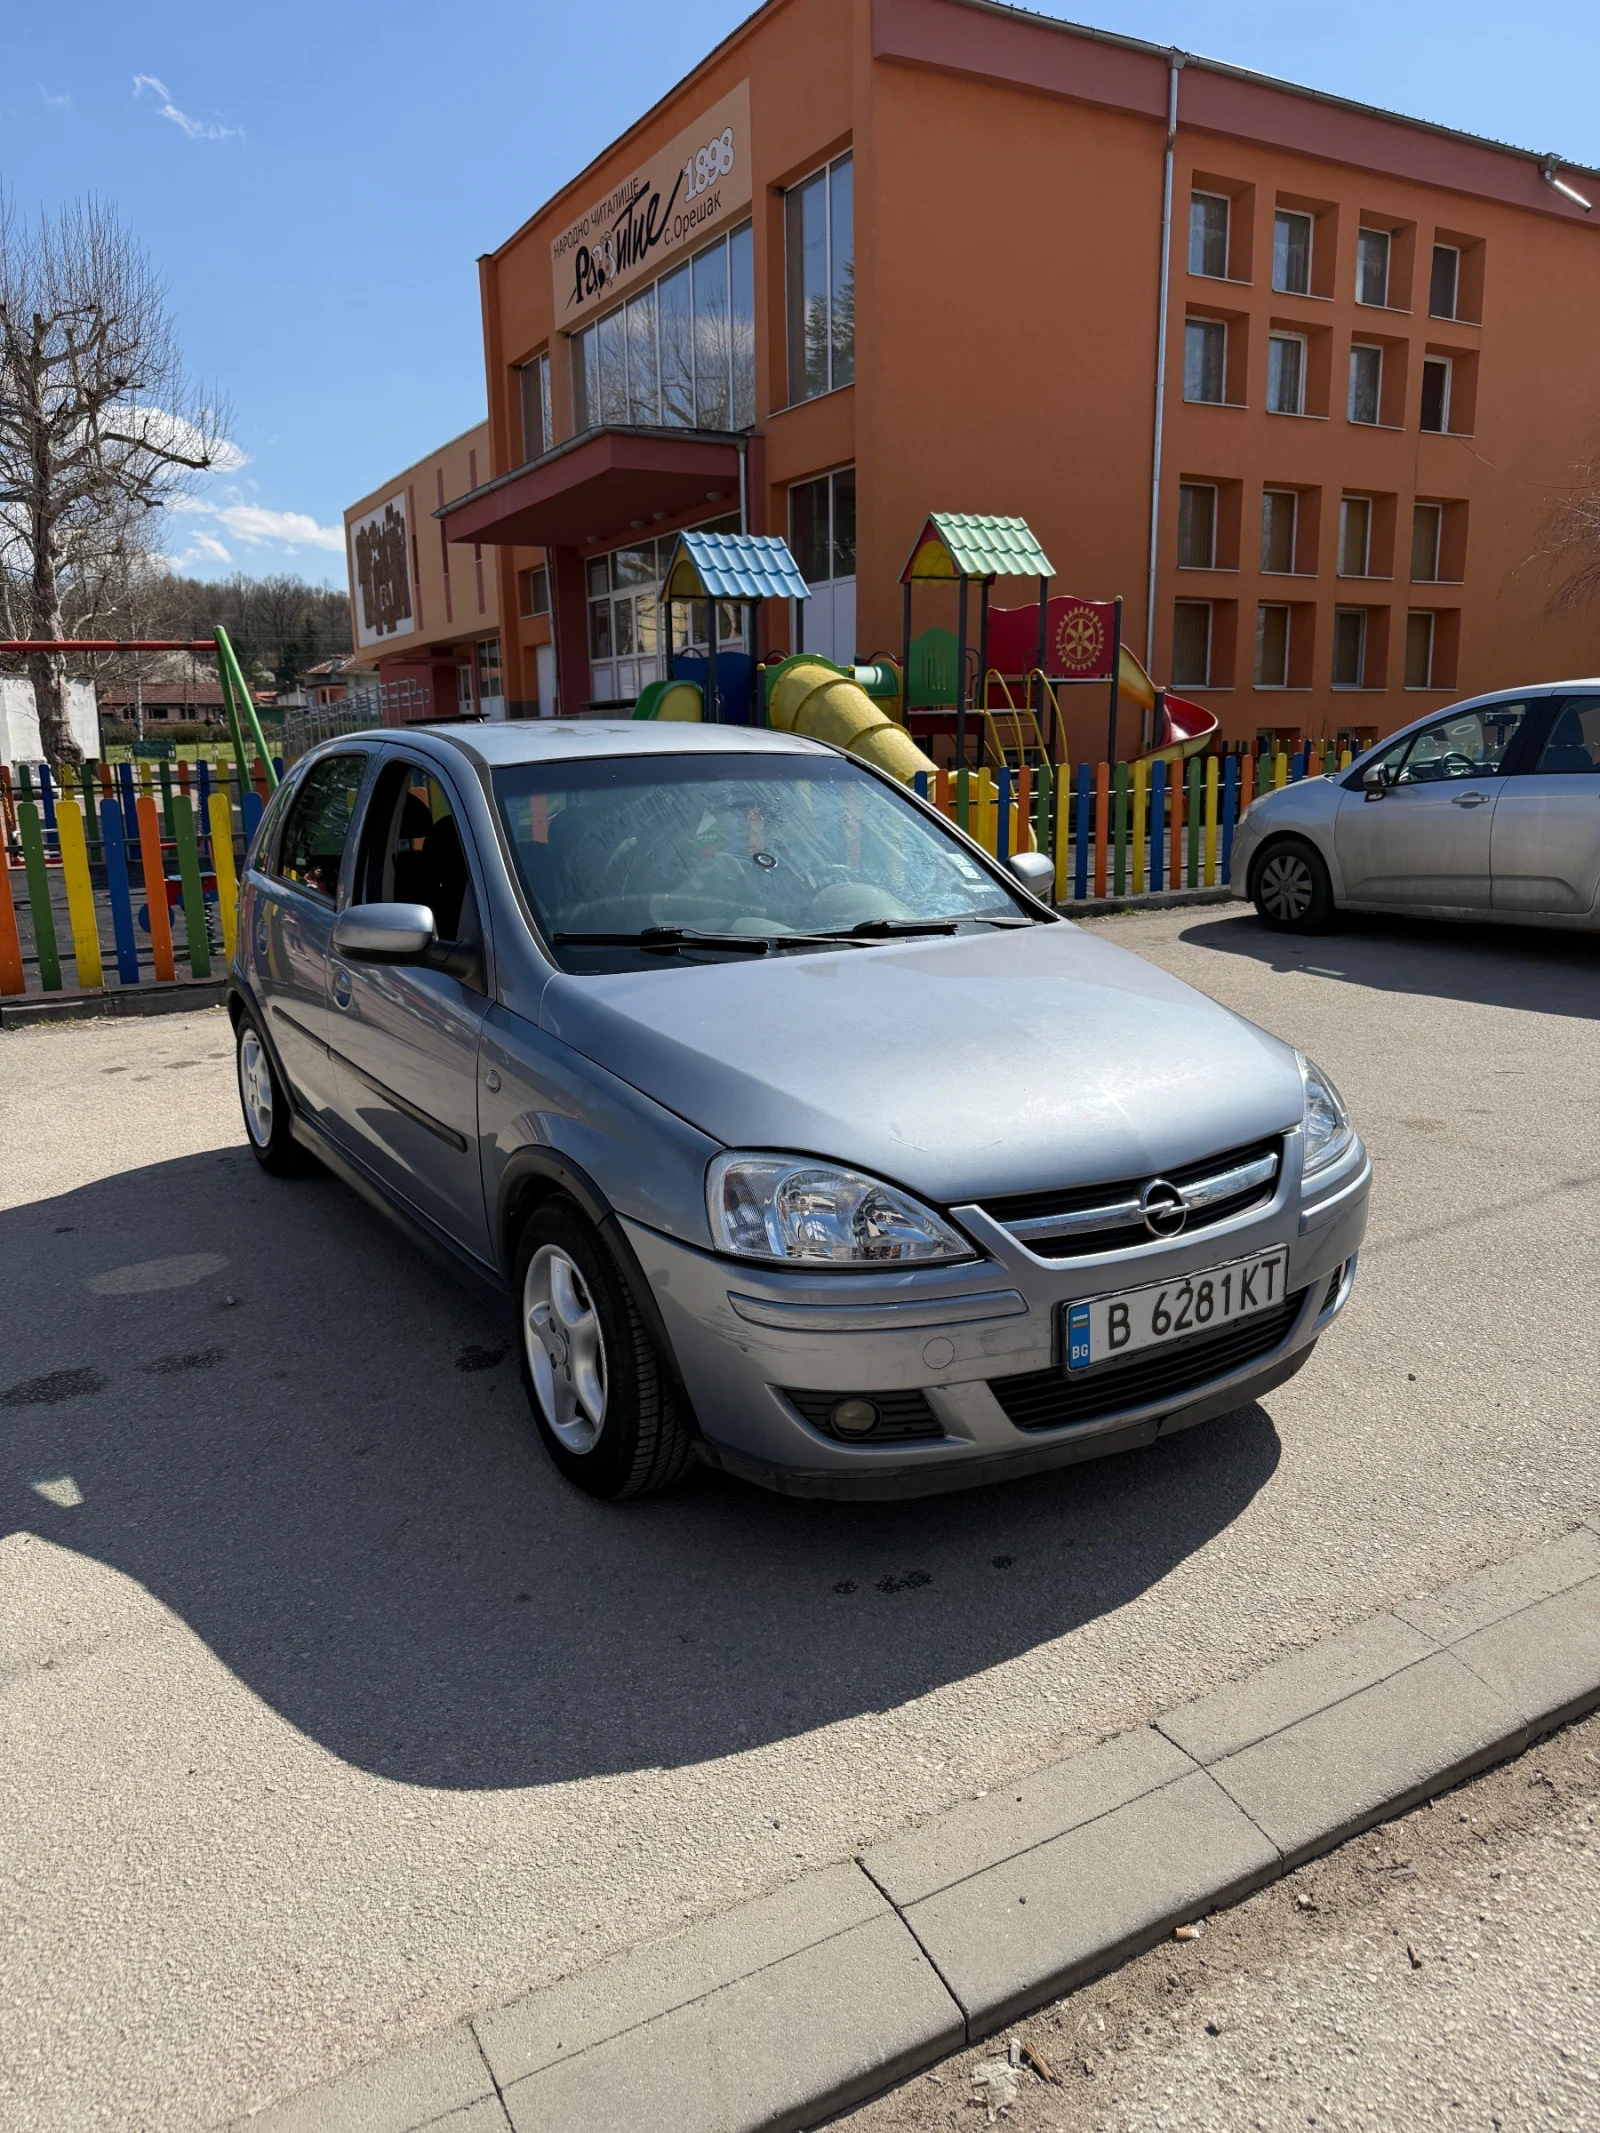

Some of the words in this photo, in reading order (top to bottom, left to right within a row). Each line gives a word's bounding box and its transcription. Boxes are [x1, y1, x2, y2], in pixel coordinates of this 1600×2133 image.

[684, 126, 735, 203] 1898
[553, 219, 589, 259] НАРОДНО
[591, 177, 639, 227] ЧИТАЛИЩЕ
[1072, 1344, 1089, 1359] BG
